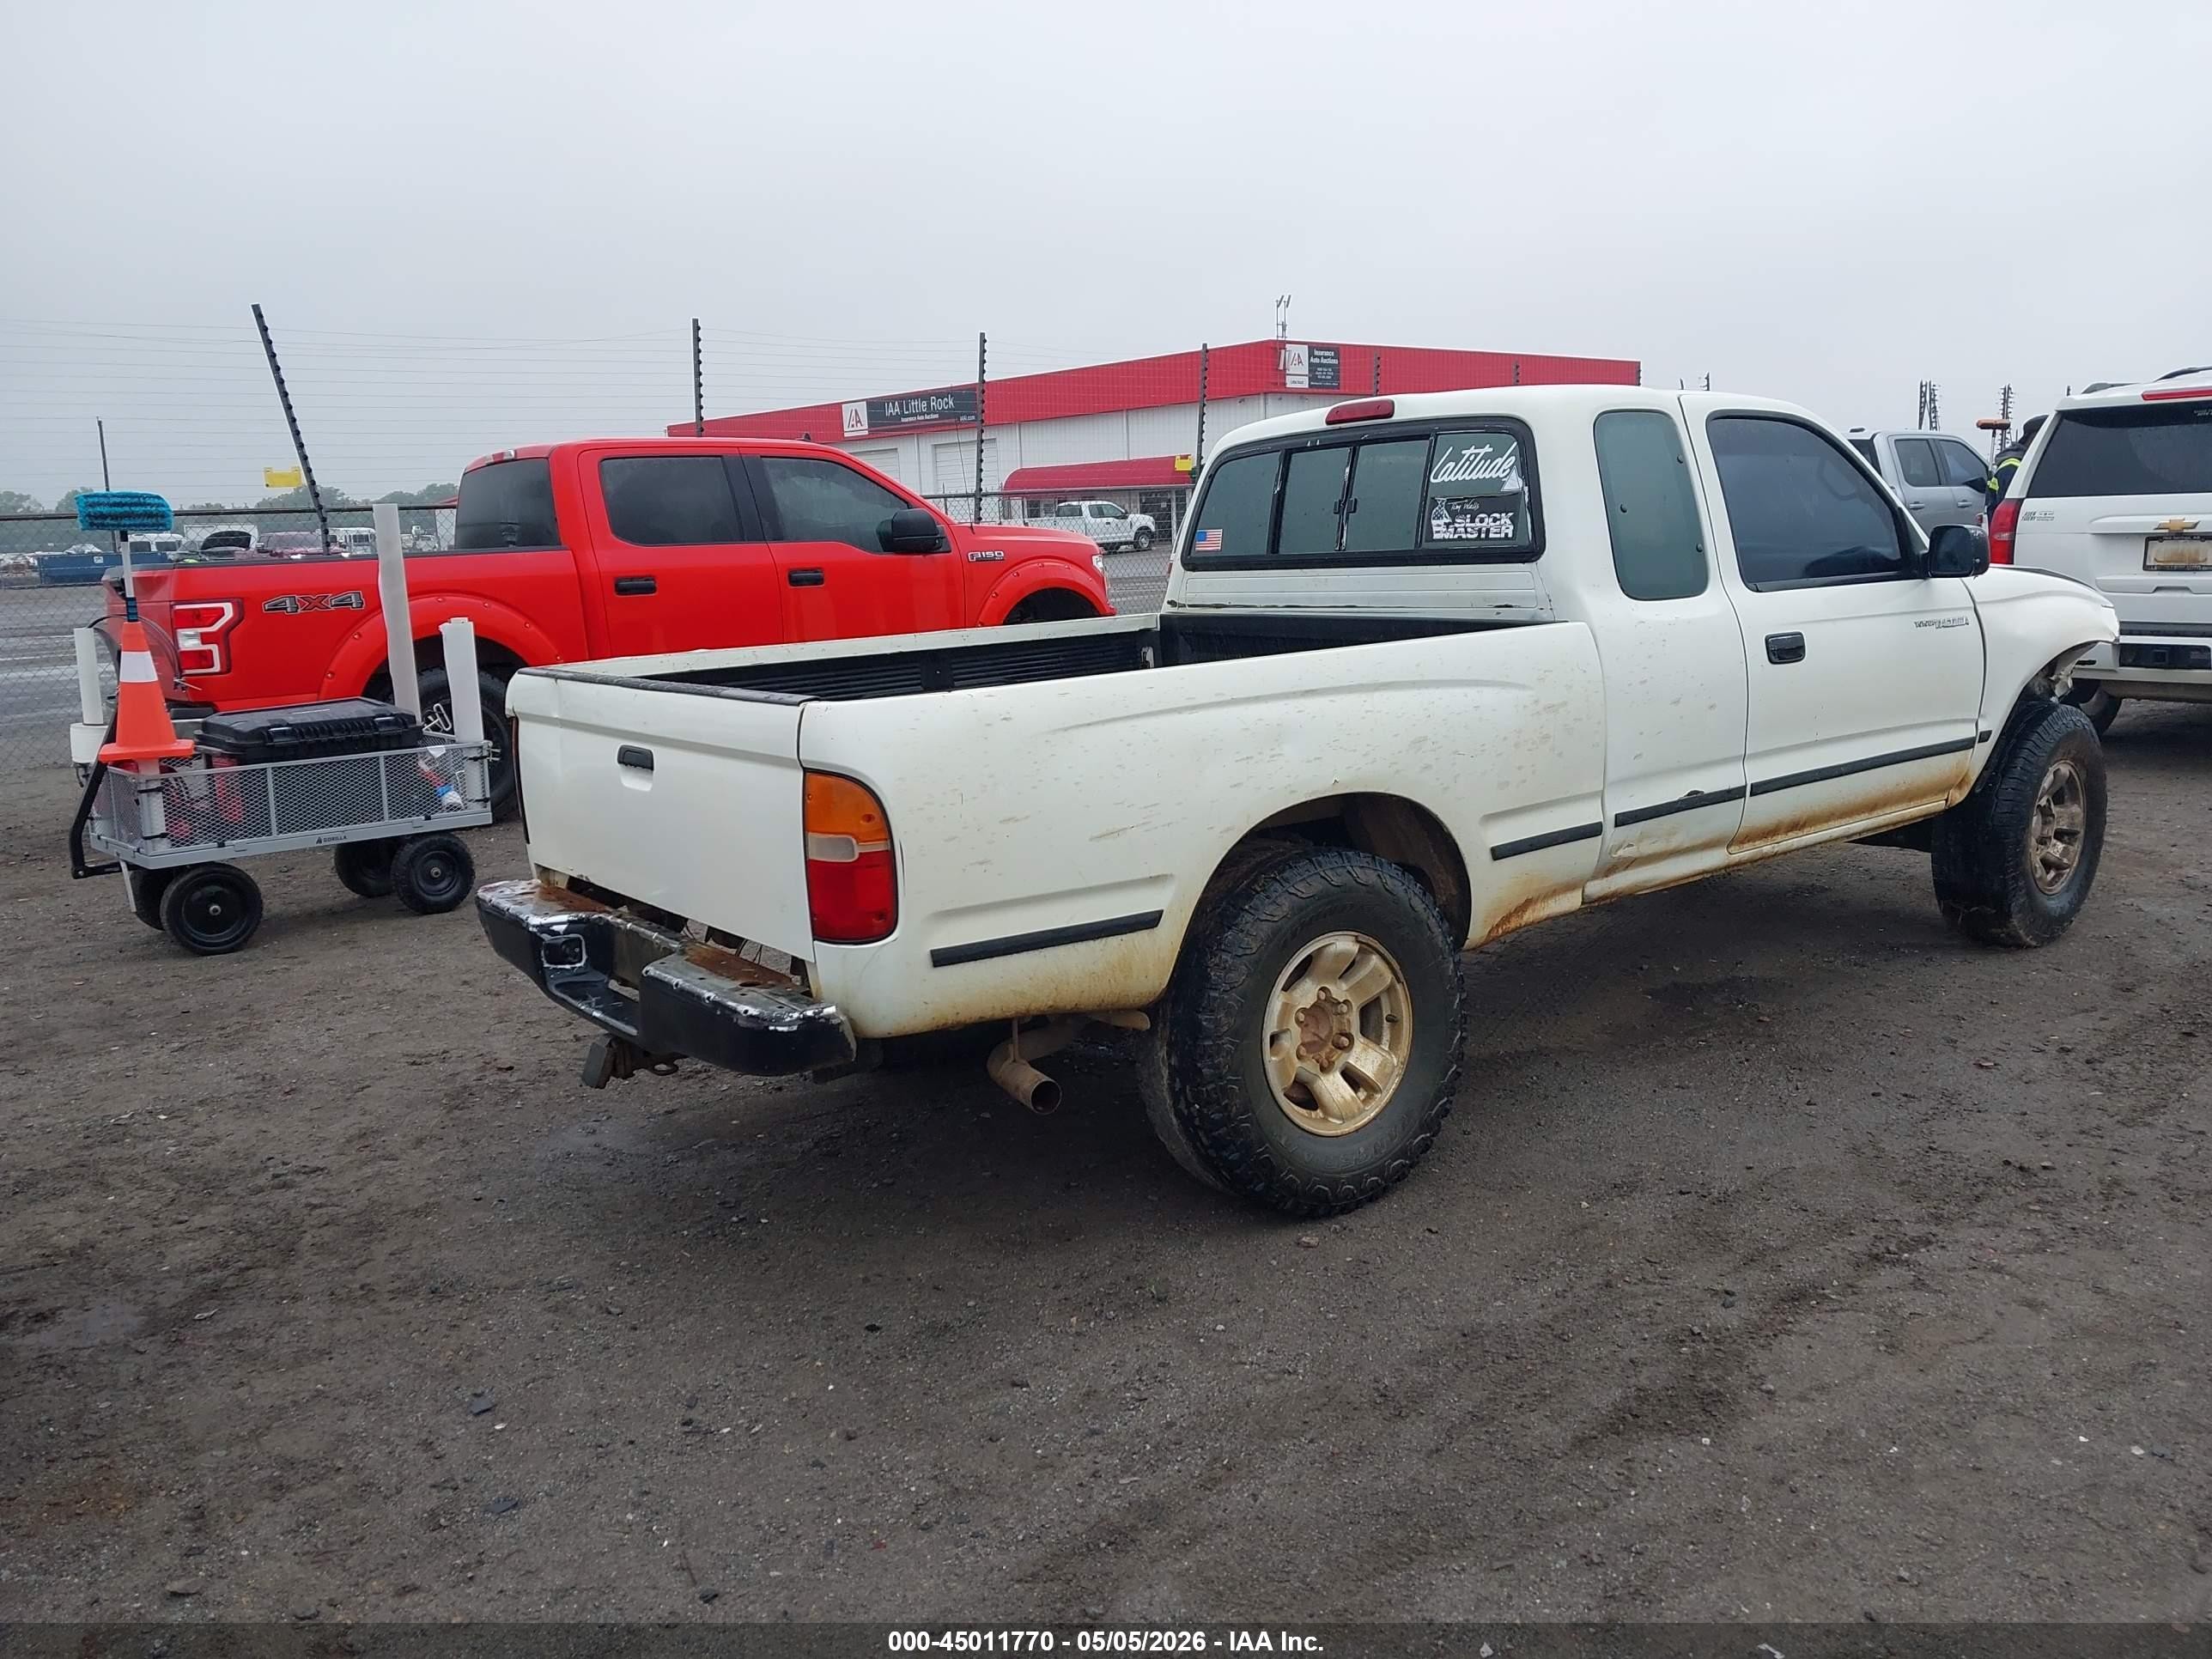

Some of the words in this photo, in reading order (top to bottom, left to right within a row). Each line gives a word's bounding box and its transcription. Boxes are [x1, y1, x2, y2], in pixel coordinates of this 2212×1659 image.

[884, 401, 901, 416] IAA
[903, 398, 927, 414] Little
[930, 394, 955, 410] Rock
[1430, 441, 1518, 483] Latitude
[1443, 525, 1514, 539] MASTER
